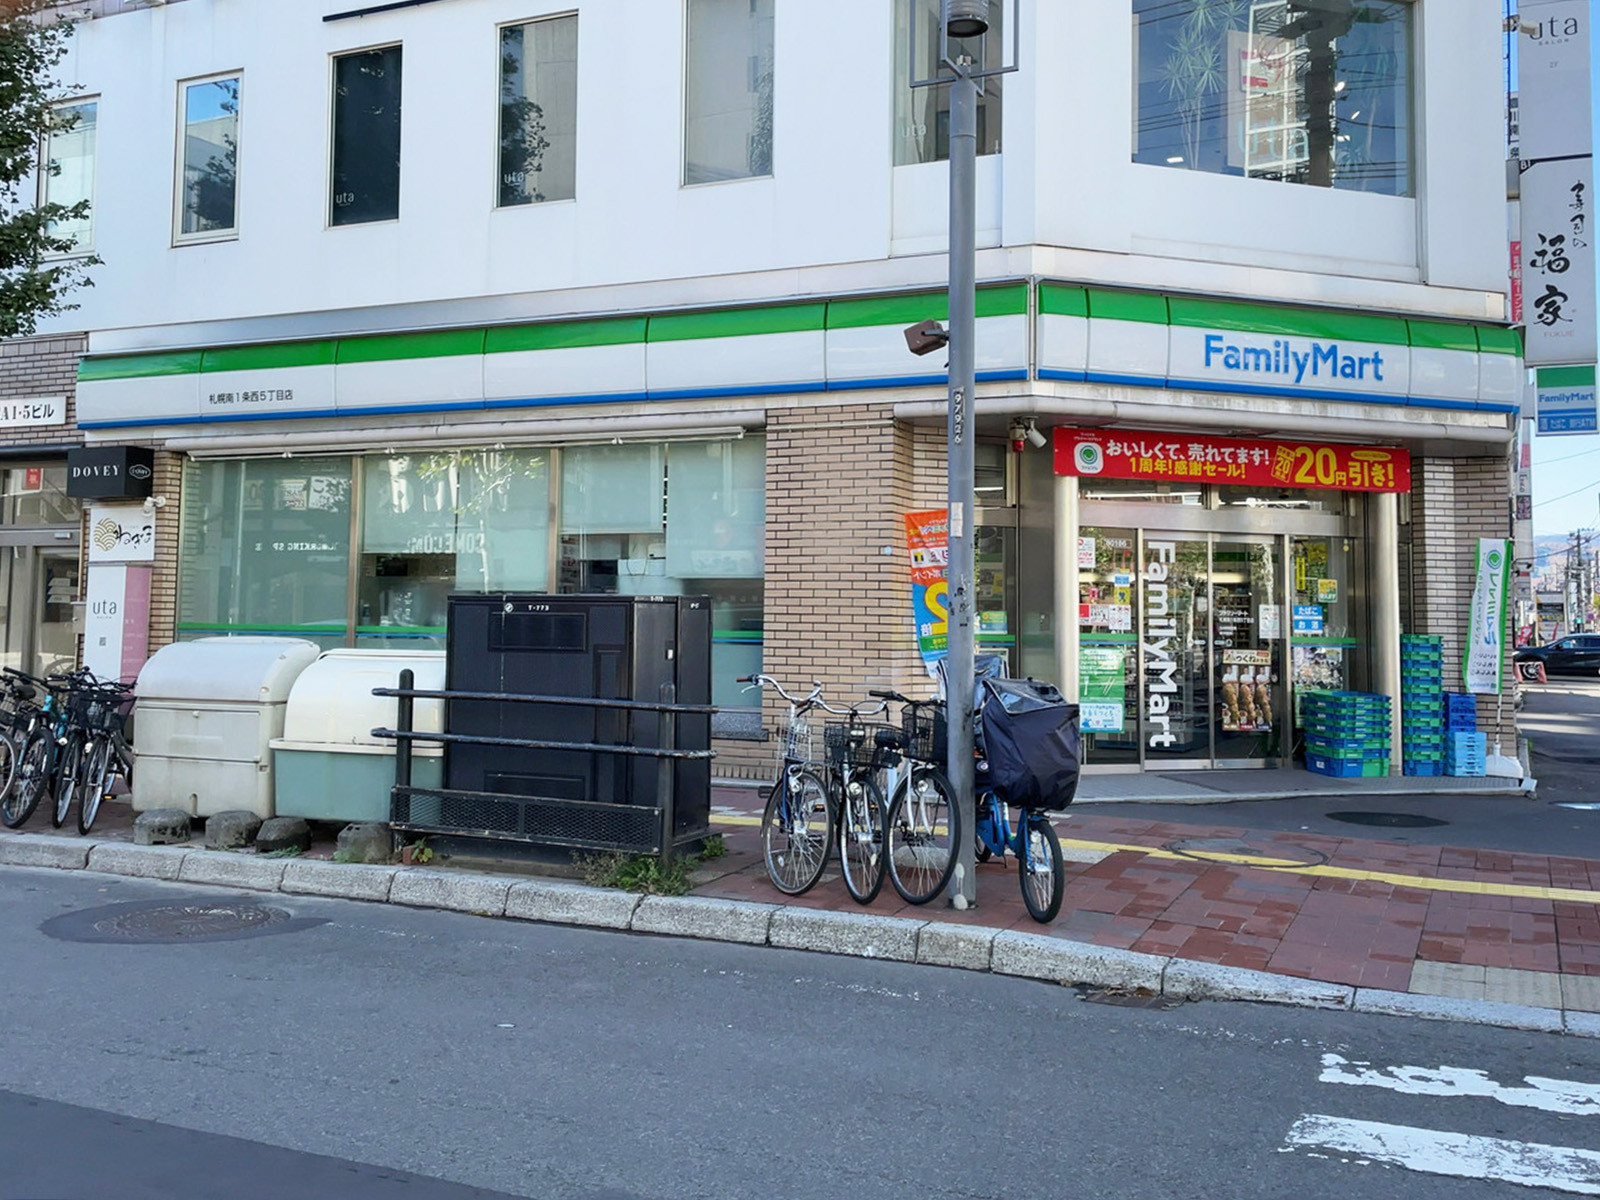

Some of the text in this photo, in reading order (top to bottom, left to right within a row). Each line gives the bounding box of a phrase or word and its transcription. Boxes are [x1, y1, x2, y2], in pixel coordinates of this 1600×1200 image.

[504, 171, 525, 184] uta
[336, 192, 355, 204] uta
[1530, 233, 1574, 326] 福家
[1204, 334, 1384, 384] FamilyMart
[1538, 392, 1594, 403] FamilyMart
[1105, 439, 1270, 466] おいしくて、売れてます!
[72, 464, 120, 478] DOVEY
[1129, 457, 1246, 479] 1周年!感謝セール!
[92, 600, 117, 615] uta
[1298, 606, 1319, 615] たばこ
[1143, 541, 1178, 747] FamilyMart
